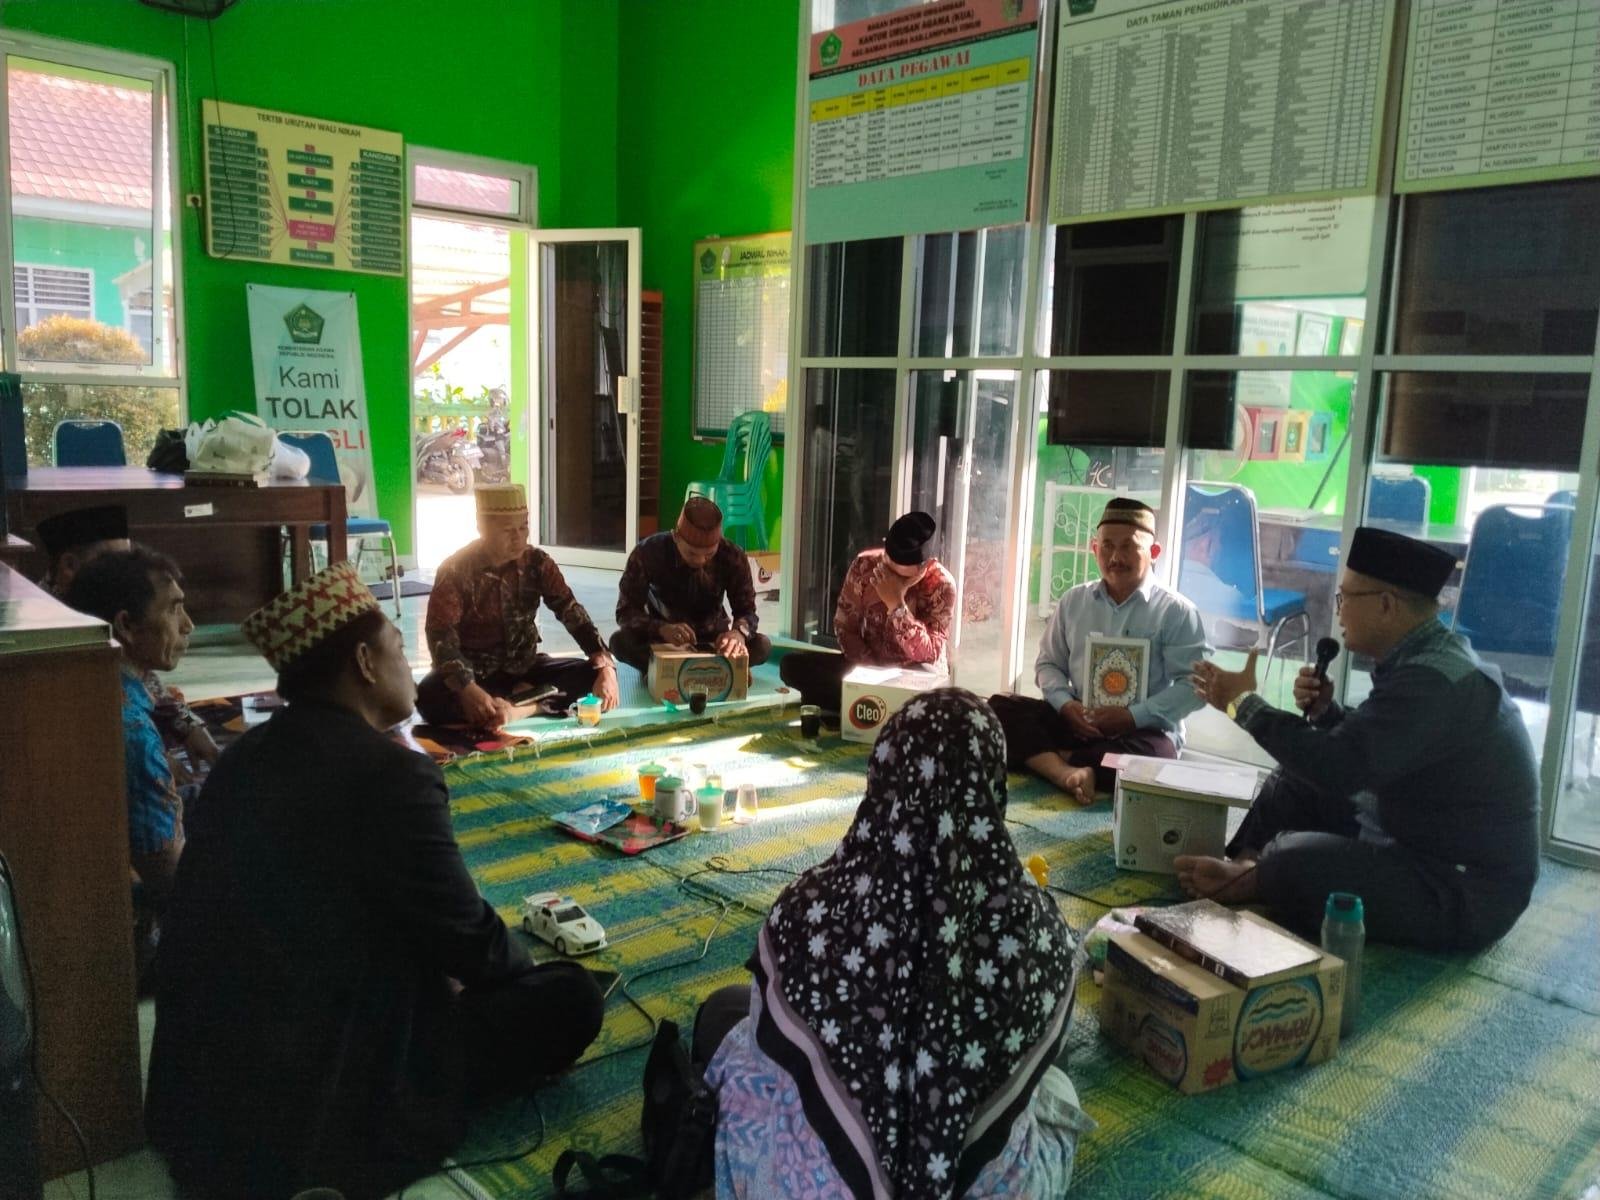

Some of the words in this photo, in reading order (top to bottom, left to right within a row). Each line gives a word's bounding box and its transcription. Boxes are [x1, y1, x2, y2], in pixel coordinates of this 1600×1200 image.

[1126, 15, 1149, 28] DATA
[1151, 8, 1182, 23] TAMAN
[1184, 0, 1240, 15] PENDIDIKAN
[858, 30, 888, 45] KANTOR
[858, 66, 894, 88] DATA
[901, 49, 971, 79] PEGAWAI
[257, 112, 283, 124] TERTIB
[284, 118, 317, 130] URUTAN
[317, 123, 337, 134] WALI
[338, 127, 361, 137] NIKAH
[740, 249, 765, 261] JADWAL
[279, 366, 339, 389] Kami
[265, 396, 358, 420] TOLAK
[856, 704, 879, 721] Cleo
